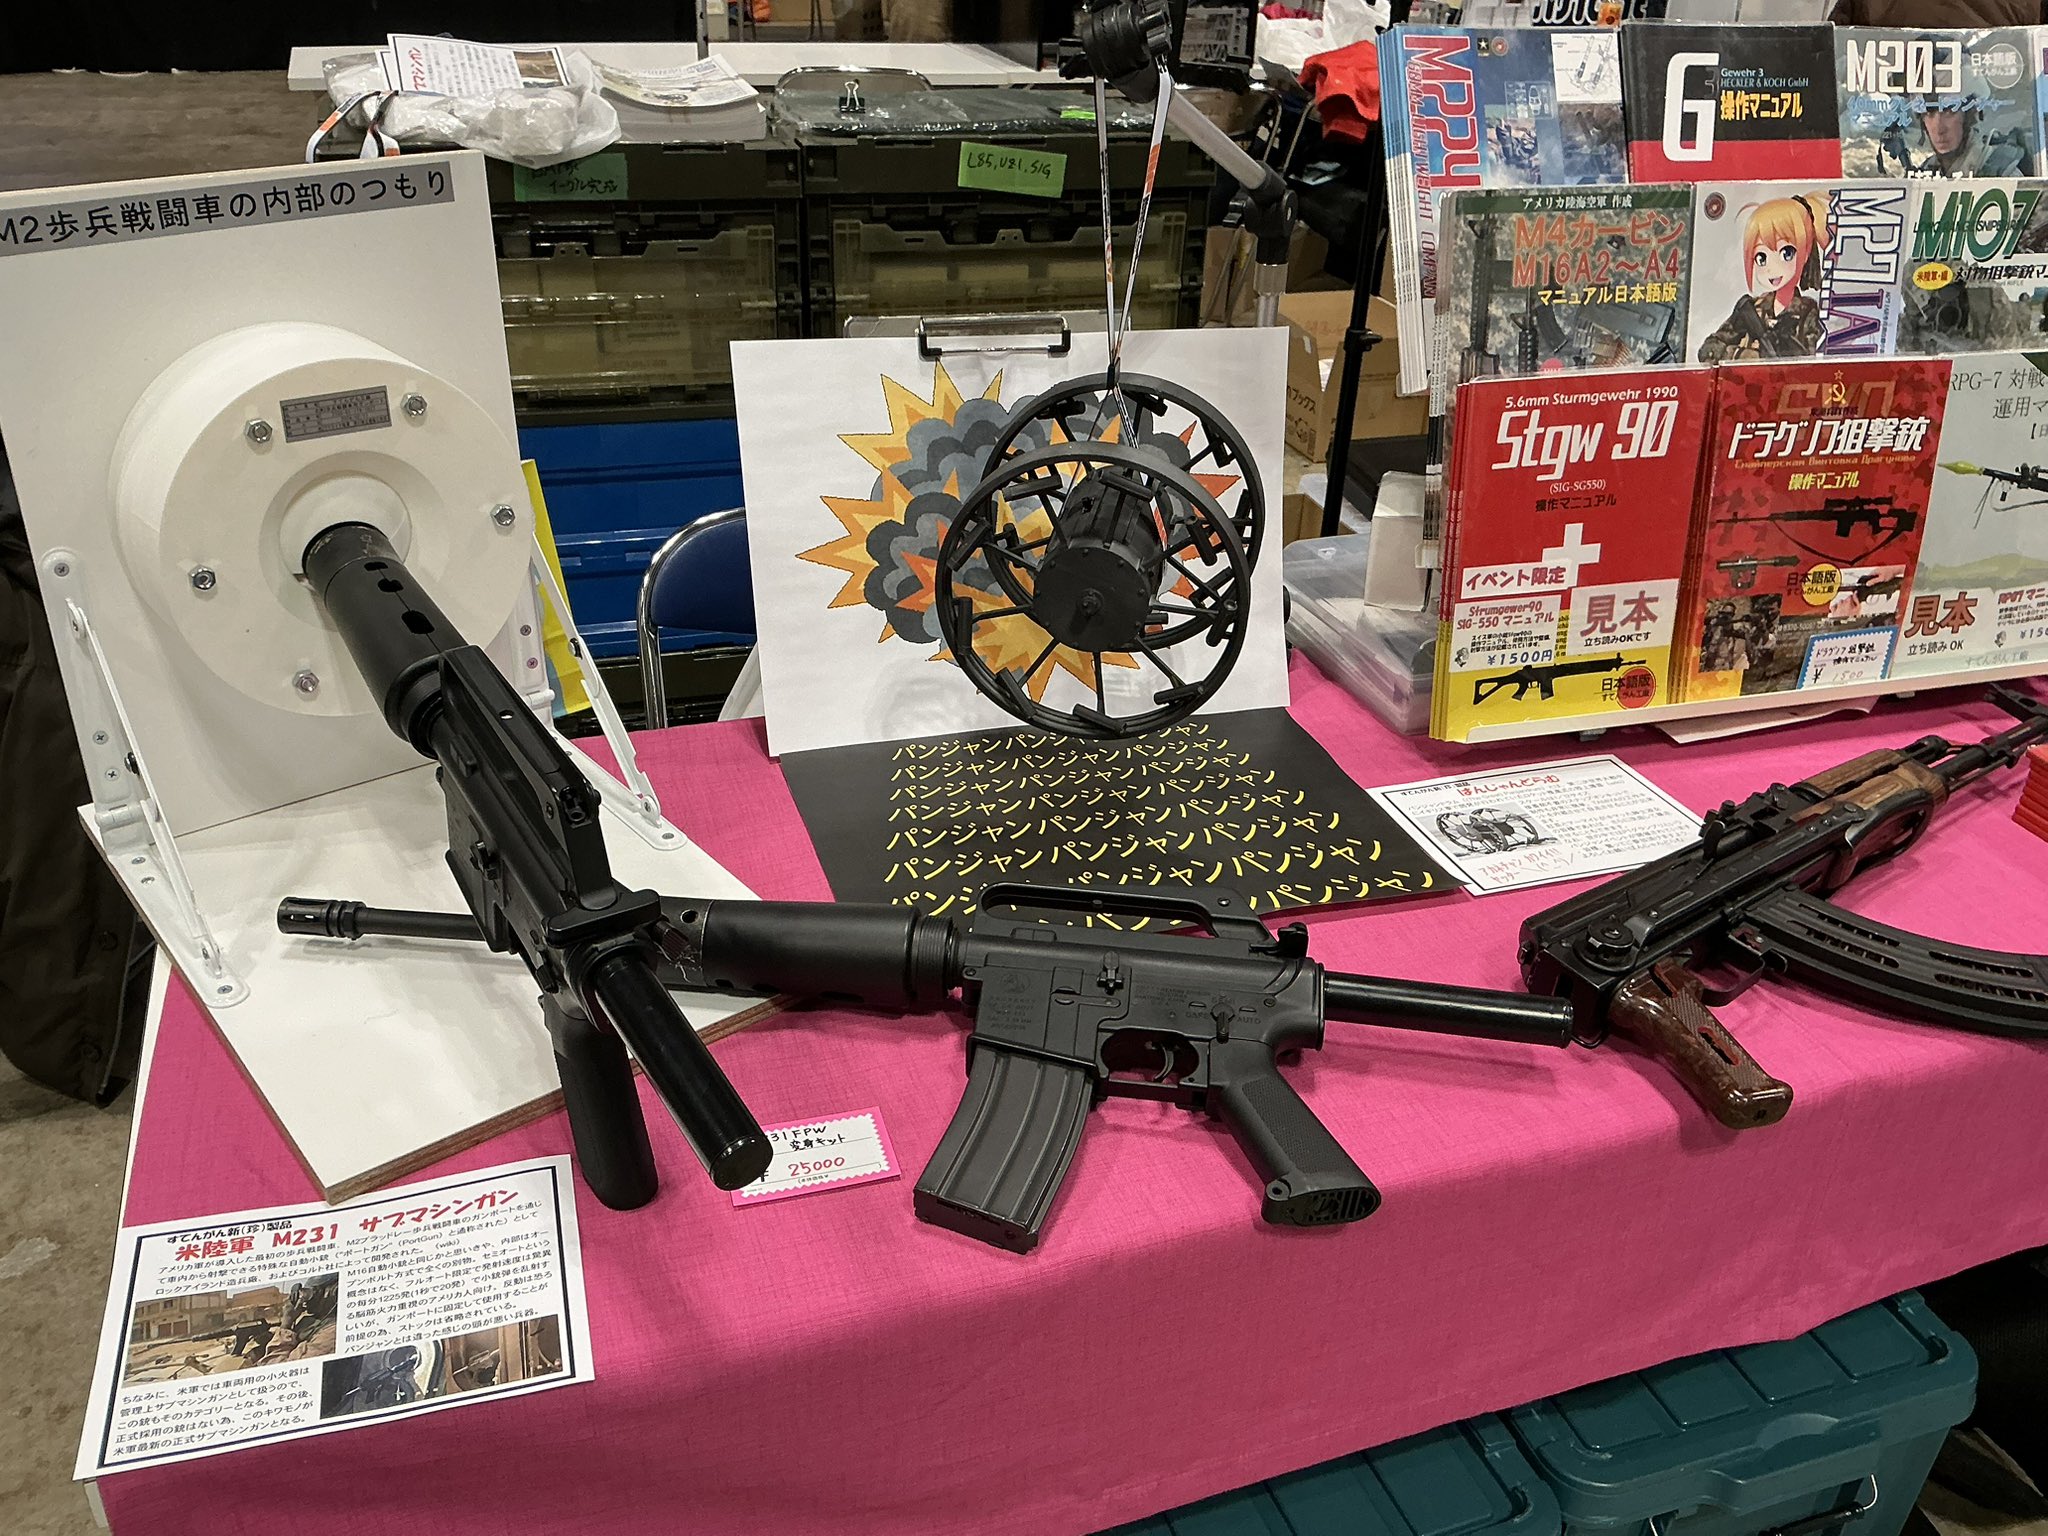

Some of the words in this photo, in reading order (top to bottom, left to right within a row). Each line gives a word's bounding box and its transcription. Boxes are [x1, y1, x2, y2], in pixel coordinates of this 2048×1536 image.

[1720, 68, 1756, 79] Gewehr
[1758, 68, 1764, 77] 3
[1846, 39, 1962, 93] M203
[1720, 77, 1755, 88] HECKLER
[1763, 77, 1786, 88] KOCH
[1403, 34, 1482, 189] M224
[1720, 90, 1803, 121] 操作マニュアル
[0, 170, 446, 245] M2歩兵戦闘車の内部のつもり
[1523, 196, 1606, 209] アメリカ陸海空軍
[1611, 194, 1632, 208] 作成
[1515, 211, 1685, 250] M4カービン
[1911, 188, 2043, 263] M107
[1538, 282, 1677, 306] マニュアル日本語版
[1505, 394, 1549, 409] 5.6mm
[1552, 389, 1641, 406] Sturmgewehr
[1645, 386, 1678, 399] 1990
[1491, 408, 1604, 482] Stgw
[1610, 400, 1679, 460] 90
[1728, 416, 1930, 460] ドラグノフ狙撃銃
[1549, 479, 1607, 493] (SIG-SG550)
[1788, 470, 1860, 491] 操作マニュアル
[1535, 494, 1617, 512] 操作マニュアル
[1466, 566, 1566, 591] イベント限定
[1787, 570, 1837, 586] 日本語版
[1457, 616, 1499, 630] SIG-550
[1502, 612, 1554, 626] マニュアル
[1580, 590, 1659, 637] 見本
[1904, 591, 1979, 638] 見本
[1584, 631, 1652, 647] 立ち読みOKです
[1602, 674, 1651, 691] 日本語版
[788, 1156, 846, 1177] 25000
[175, 1235, 255, 1262] 米陸軍
[272, 1223, 339, 1248] M231
[359, 1190, 519, 1232] サブマシンガン
